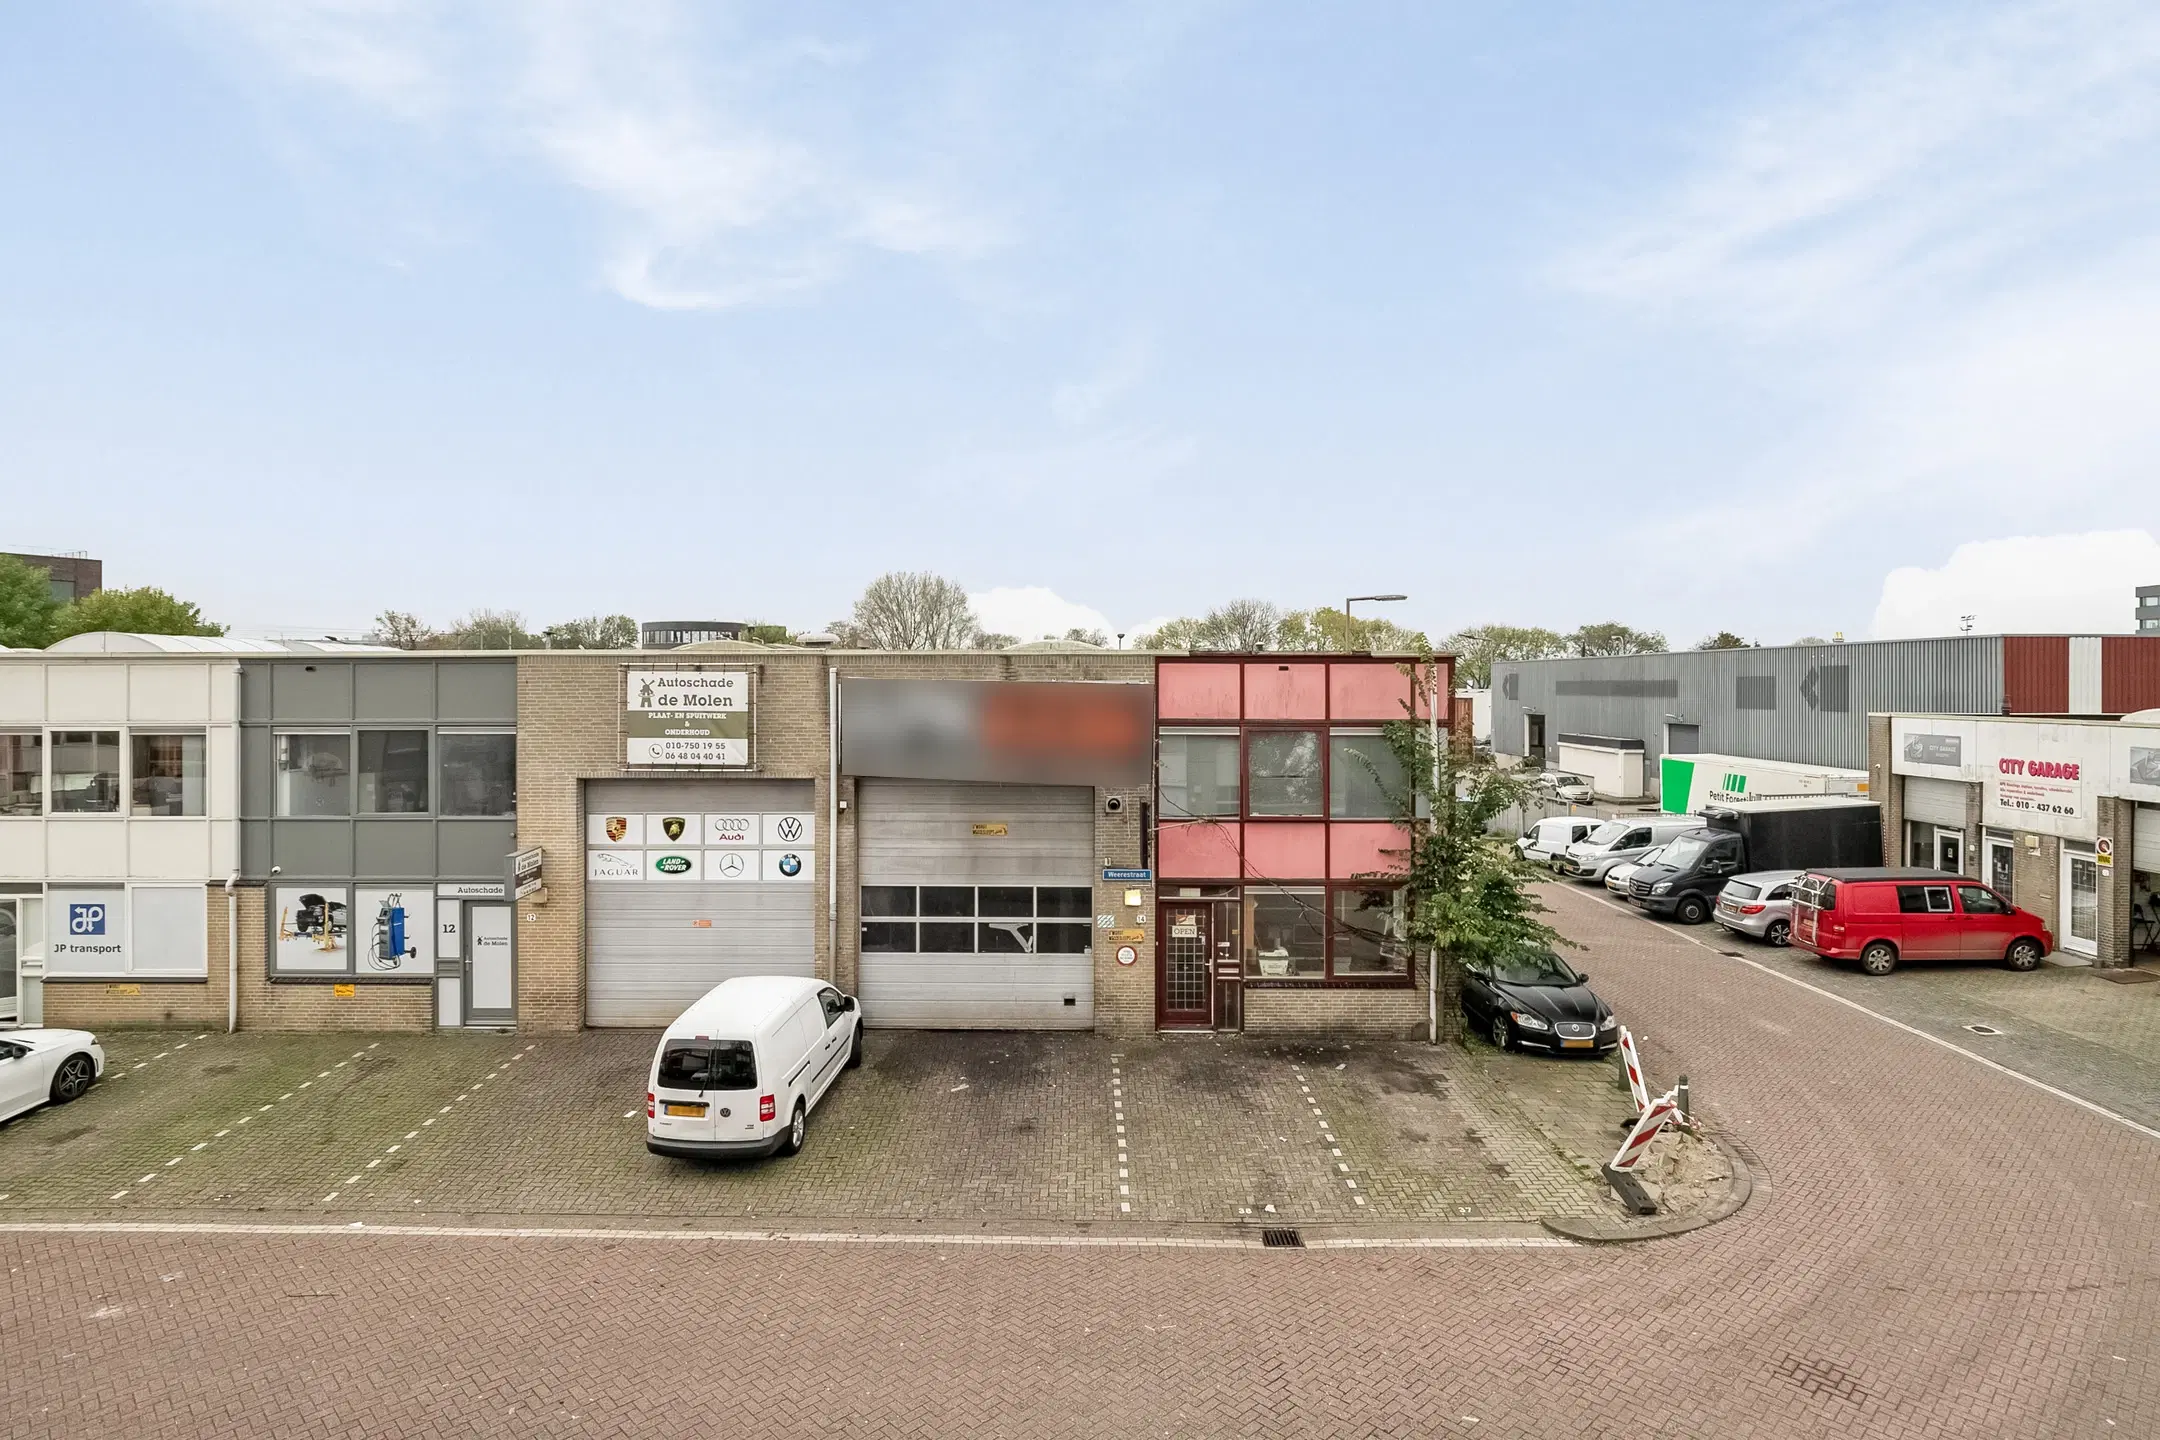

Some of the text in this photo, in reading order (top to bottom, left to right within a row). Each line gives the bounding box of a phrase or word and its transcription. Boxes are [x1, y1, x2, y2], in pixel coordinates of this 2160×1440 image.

[657, 677, 734, 688] Autoschade
[658, 694, 733, 707] de Molen
[686, 712, 727, 720] SPUITWERK
[665, 742, 726, 750] 010-750 19 55
[665, 752, 726, 760] 06 48 04 40 41
[1999, 758, 2080, 780] CITY GARAGE
[1709, 790, 1725, 802] Petit
[2000, 799, 2014, 807] Tel.:
[2016, 801, 2030, 809] 010
[2037, 803, 2050, 812] 437
[2052, 805, 2062, 814] 62
[2064, 807, 2074, 815] 60
[719, 833, 744, 841] Audi
[594, 868, 639, 876] JAGUAR
[457, 886, 503, 894] Autoschade
[443, 924, 456, 934] 12
[1173, 928, 1196, 936] OPEN
[54, 944, 122, 955] JP transport
